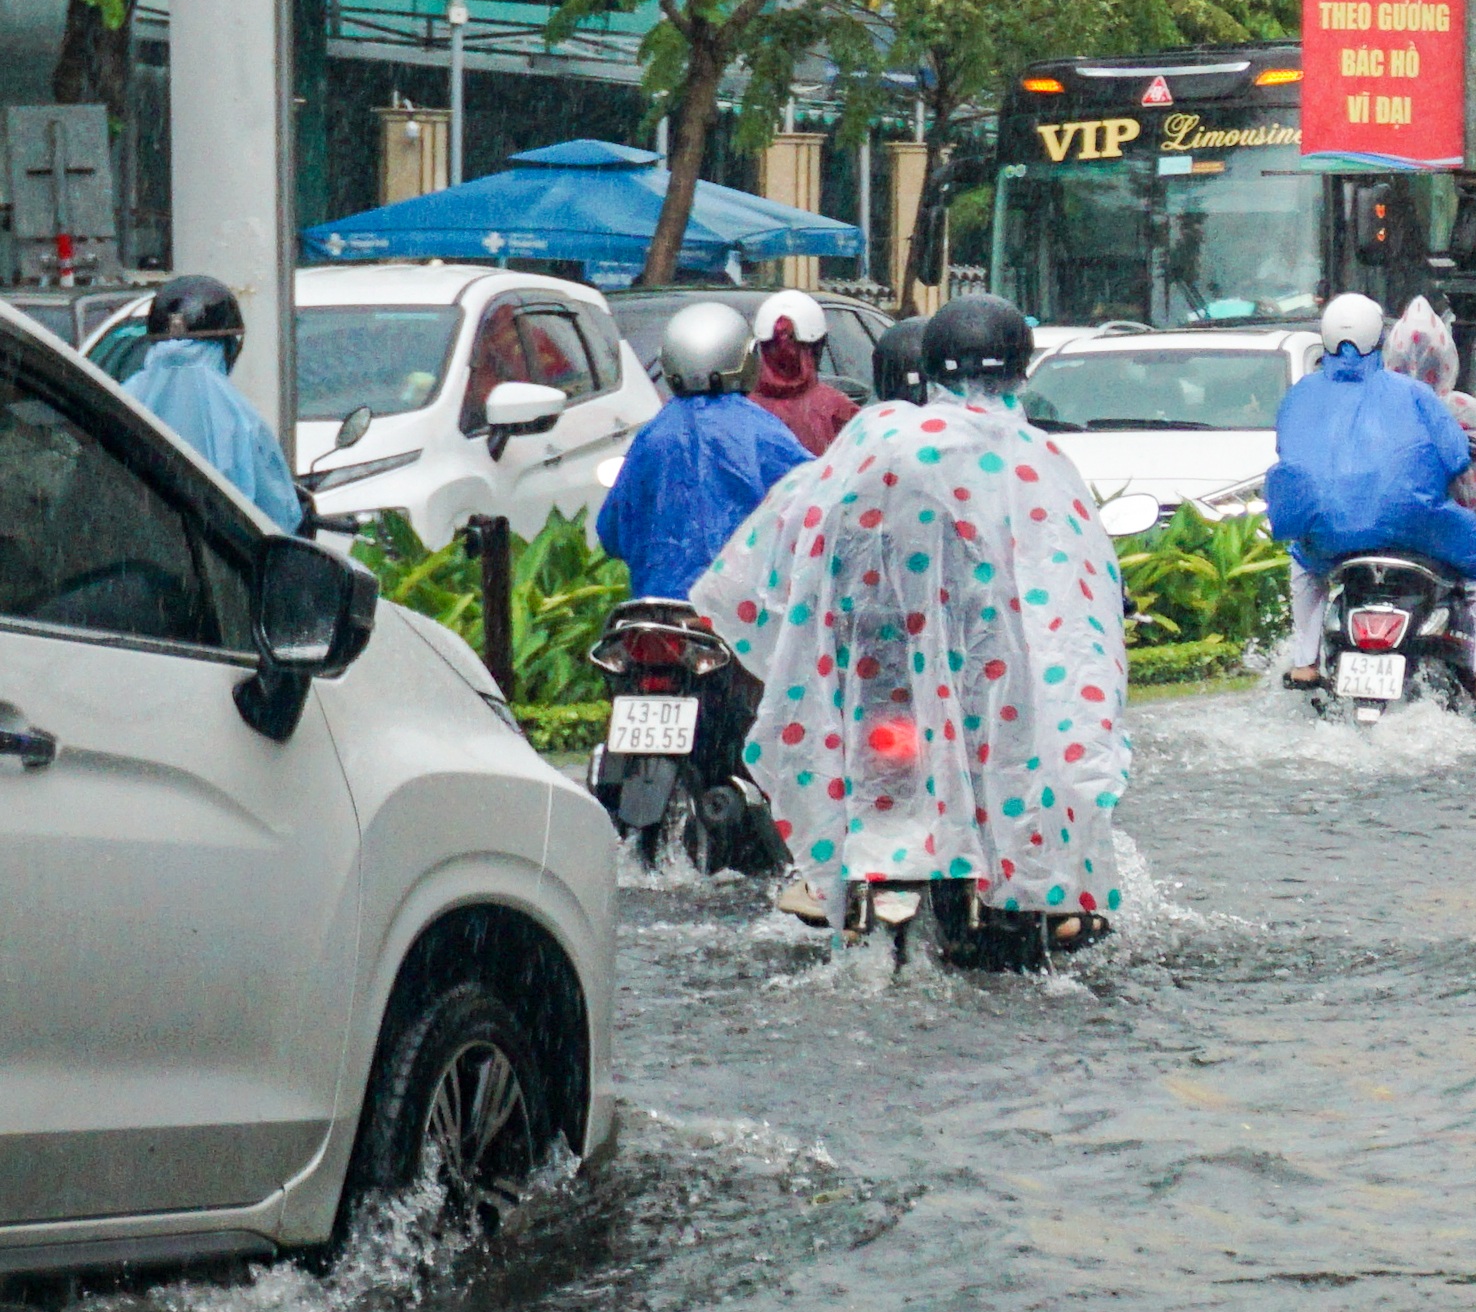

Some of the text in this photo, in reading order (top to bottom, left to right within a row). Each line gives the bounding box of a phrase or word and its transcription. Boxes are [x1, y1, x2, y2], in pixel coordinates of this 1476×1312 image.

[1318, 0, 1451, 32] THEO GƯƠNG
[1341, 40, 1420, 78] BÁC HỒ
[1346, 91, 1412, 130] VĨ ĐẠI
[1037, 118, 1140, 162] VIP
[1350, 657, 1393, 676] 43-AA
[1342, 676, 1396, 696] 214.14
[627, 702, 682, 725] 43-D1
[616, 727, 688, 749] 785.55
